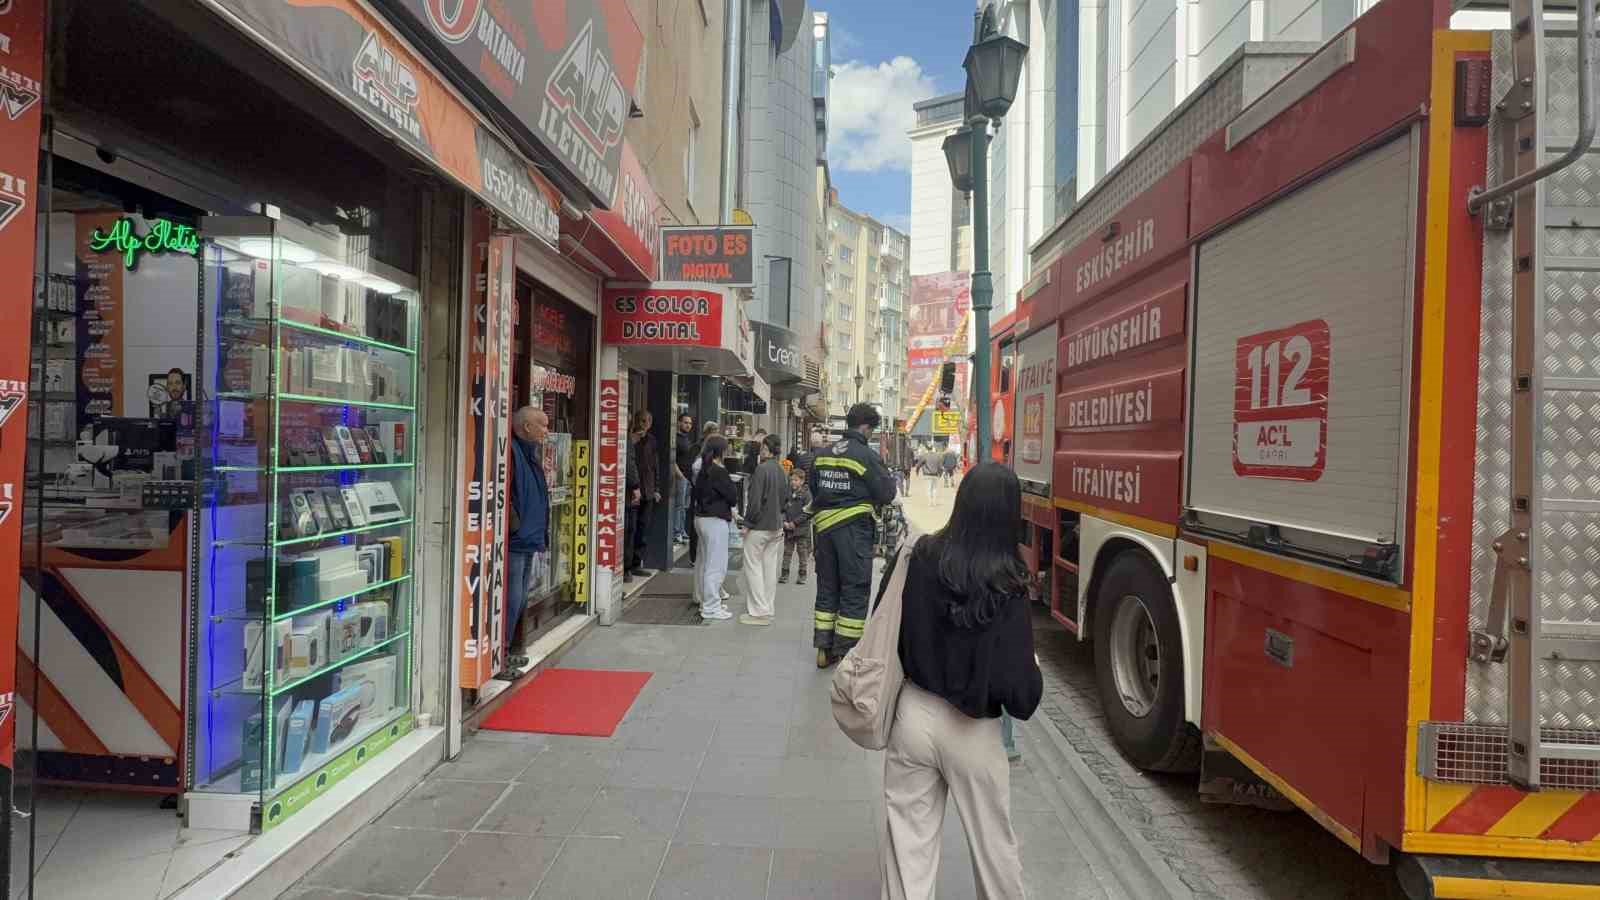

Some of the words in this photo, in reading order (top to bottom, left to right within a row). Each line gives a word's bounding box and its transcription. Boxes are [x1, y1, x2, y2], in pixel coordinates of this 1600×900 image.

[352, 31, 420, 114] ALP
[478, 7, 527, 85] BATARYA
[546, 18, 625, 160] ALP
[90, 219, 141, 267] Alp
[667, 234, 717, 257] FOTO
[723, 233, 748, 257] ES
[1076, 218, 1155, 293] ESKİŞEHİR
[469, 241, 489, 416] TEKNİK
[615, 296, 637, 313] ES
[644, 296, 709, 316] COLOR
[1068, 306, 1161, 368] BÜYÜKŞEHİR
[1068, 382, 1152, 427] BELEDİYESİ
[1248, 335, 1312, 409] 112
[600, 386, 617, 447] ACELE
[1072, 461, 1141, 504] İTFAİYESİ
[463, 480, 482, 659] SERVİS
